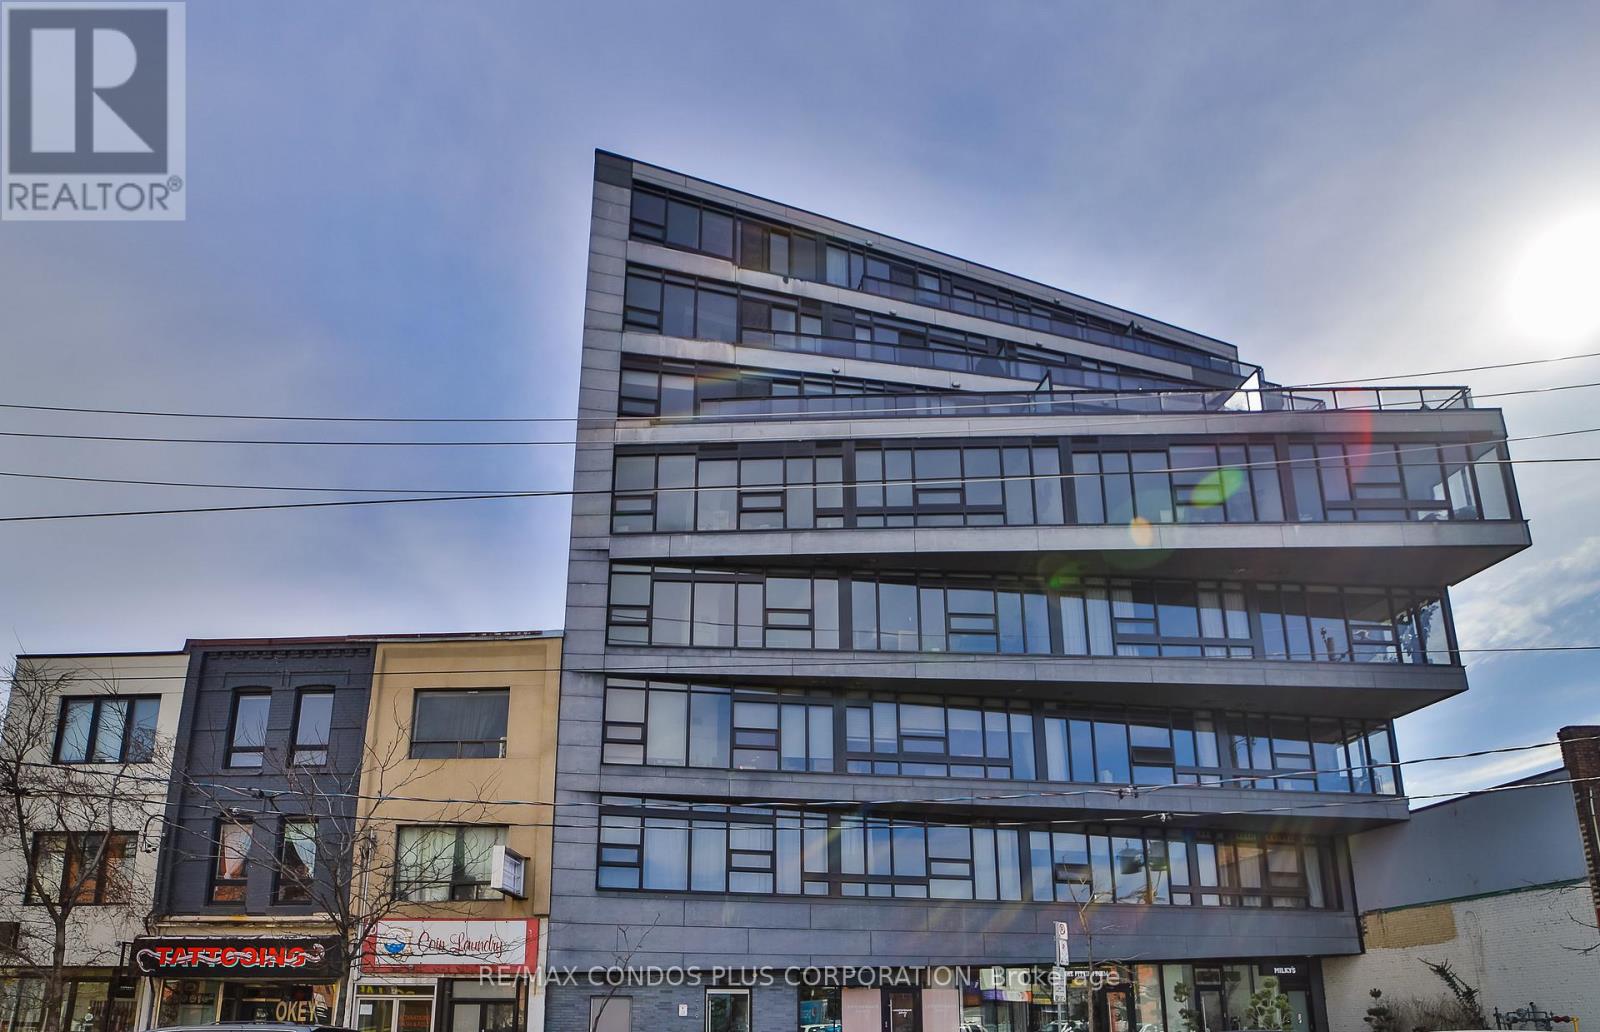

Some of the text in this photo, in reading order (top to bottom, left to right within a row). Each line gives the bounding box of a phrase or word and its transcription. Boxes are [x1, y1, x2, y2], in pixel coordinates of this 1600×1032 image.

[418, 931, 503, 959] Coin Laundry
[155, 946, 305, 968] TATTOOING
[275, 1000, 317, 1022] OKEY
